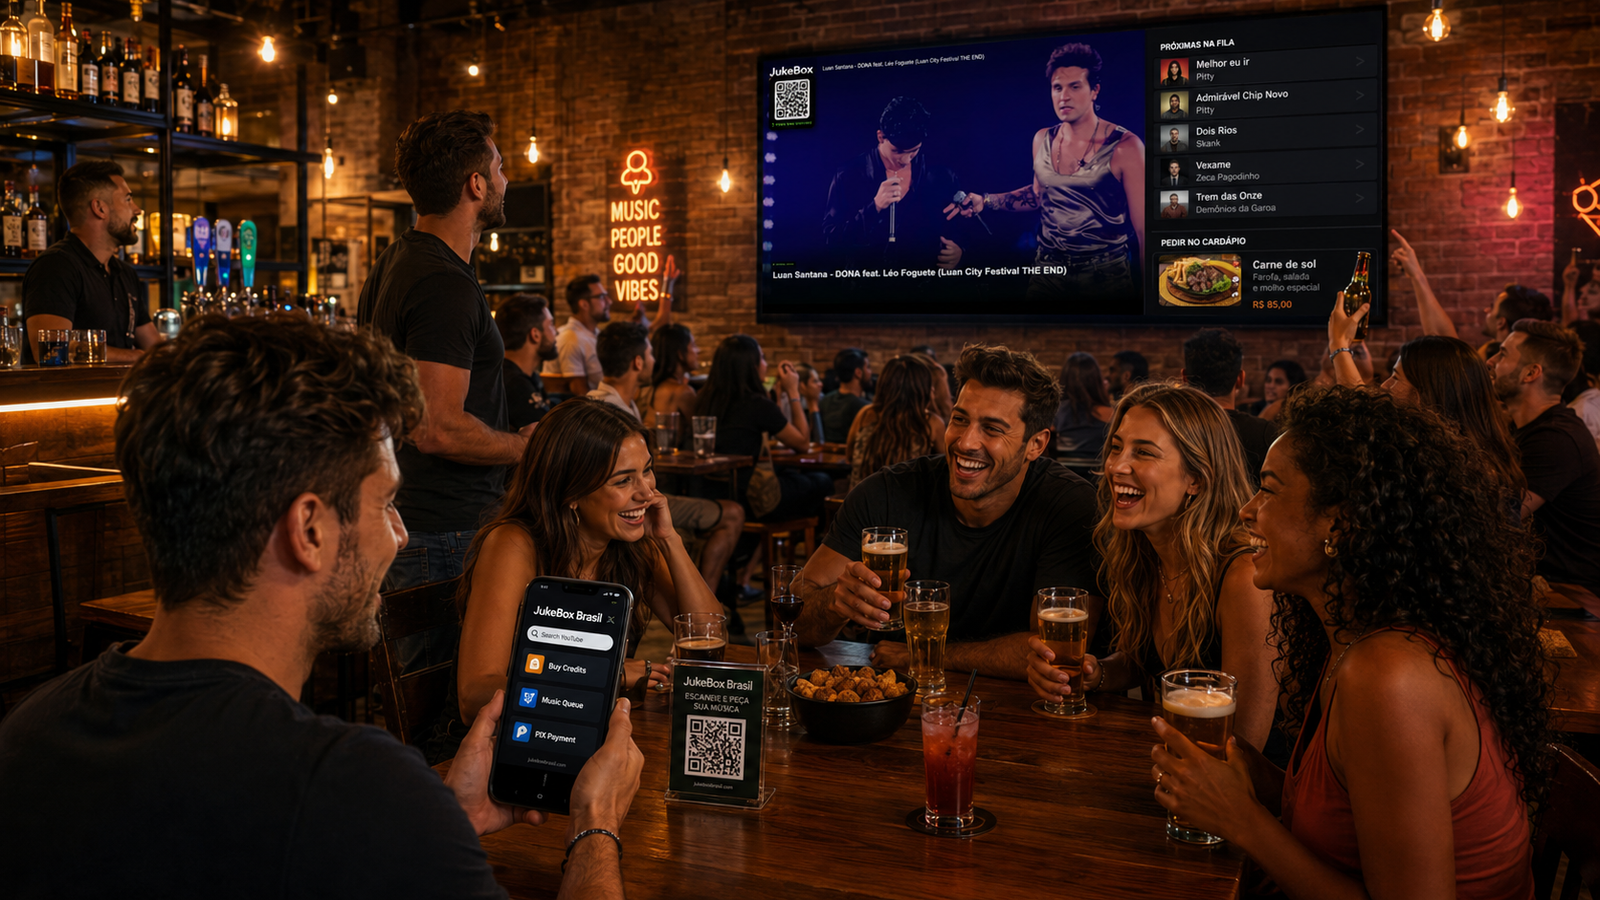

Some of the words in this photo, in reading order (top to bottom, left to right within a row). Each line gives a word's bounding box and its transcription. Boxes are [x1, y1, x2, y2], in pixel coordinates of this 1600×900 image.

[1160, 41, 1201, 51] PRÓXIMAS
[1203, 40, 1215, 48] NA
[1217, 39, 1235, 47] FILA
[1196, 59, 1228, 69] Melhor
[1243, 57, 1250, 66] ir
[769, 65, 814, 77] JukeBox
[1196, 73, 1215, 82] Pitty
[1196, 91, 1240, 102] Admirável
[1242, 90, 1263, 101] Chip
[1265, 90, 1289, 99] Novo
[1196, 106, 1215, 115] Pitty
[1196, 127, 1216, 136] Dois
[1217, 126, 1238, 135] Rios
[1196, 139, 1221, 148] Skank
[1196, 161, 1231, 169] Vexame
[1196, 174, 1216, 182] Zeca
[1217, 172, 1260, 182] Pagodinho
[1196, 192, 1219, 201] Trem
[1220, 192, 1237, 201] das
[1239, 191, 1263, 200] Onze
[610, 198, 660, 223] MUSIC
[1238, 204, 1249, 212] da
[1251, 203, 1276, 212] Garoa
[611, 225, 662, 249] PEOPLE
[1161, 238, 1186, 247] PEDIR
[1187, 238, 1200, 246] NO
[1202, 236, 1246, 246] CARDÁPIO
[613, 251, 659, 275] GOOD
[1252, 260, 1283, 269] Carne
[1285, 259, 1298, 269] de
[1300, 259, 1317, 269] sol
[772, 271, 793, 279] Luan
[794, 270, 828, 279] Santana
[835, 269, 860, 278] DONA
[862, 269, 881, 278] feat.
[882, 268, 899, 277] Léo
[901, 268, 936, 279] Foguete
[938, 267, 963, 278] (Luan
[965, 266, 983, 278] City
[985, 266, 1020, 276] Festival
[1022, 266, 1041, 275] THE
[1043, 265, 1067, 276] END)
[1252, 272, 1281, 282] Farofa,
[1282, 272, 1310, 281] salada
[614, 278, 659, 302] VIBES
[1260, 282, 1285, 292] molho
[1286, 282, 1320, 293] especial
[1252, 299, 1265, 310] R$
[1266, 299, 1293, 310] 85,00
[533, 605, 575, 619] JukeBox
[575, 610, 603, 623] Brasil
[541, 631, 560, 640] Search
[561, 634, 584, 643] YouTube
[548, 662, 562, 672] Buy
[562, 664, 587, 674] Credits
[683, 676, 725, 689] JukeBox
[726, 679, 753, 691] Brasil
[541, 696, 561, 706] Music
[561, 699, 584, 709] Queue
[722, 695, 728, 703] E
[729, 695, 750, 705] PEÇA
[693, 702, 710, 711] SUA
[534, 730, 547, 739] PIX
[547, 732, 576, 743] Payment
